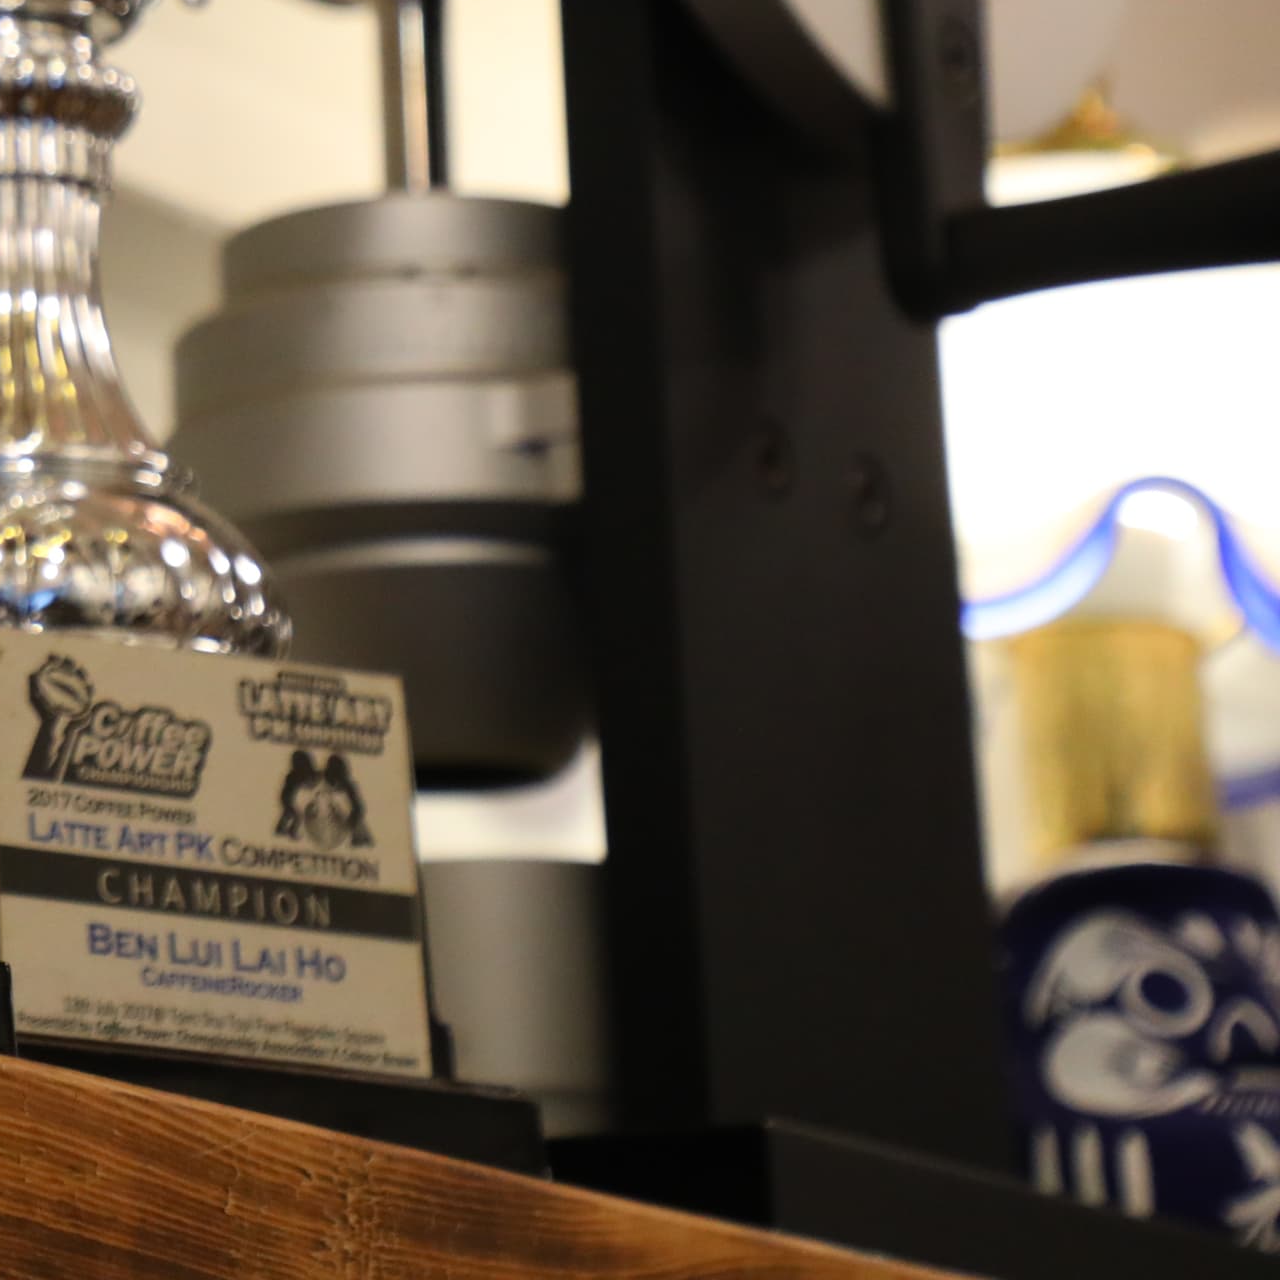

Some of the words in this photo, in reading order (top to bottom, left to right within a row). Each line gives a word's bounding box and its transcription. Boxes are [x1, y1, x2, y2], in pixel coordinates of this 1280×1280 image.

[73, 734, 200, 779] POWER
[28, 788, 72, 808] 2017
[28, 812, 110, 851] LATTE
[117, 825, 168, 858] ART
[176, 830, 214, 861] PK
[220, 838, 380, 882] COMPETITION
[97, 869, 331, 926] CHAMPION
[88, 923, 159, 960] BEN
[168, 931, 223, 967] LUI
[232, 938, 286, 974] LAI
[296, 946, 347, 982] HO
